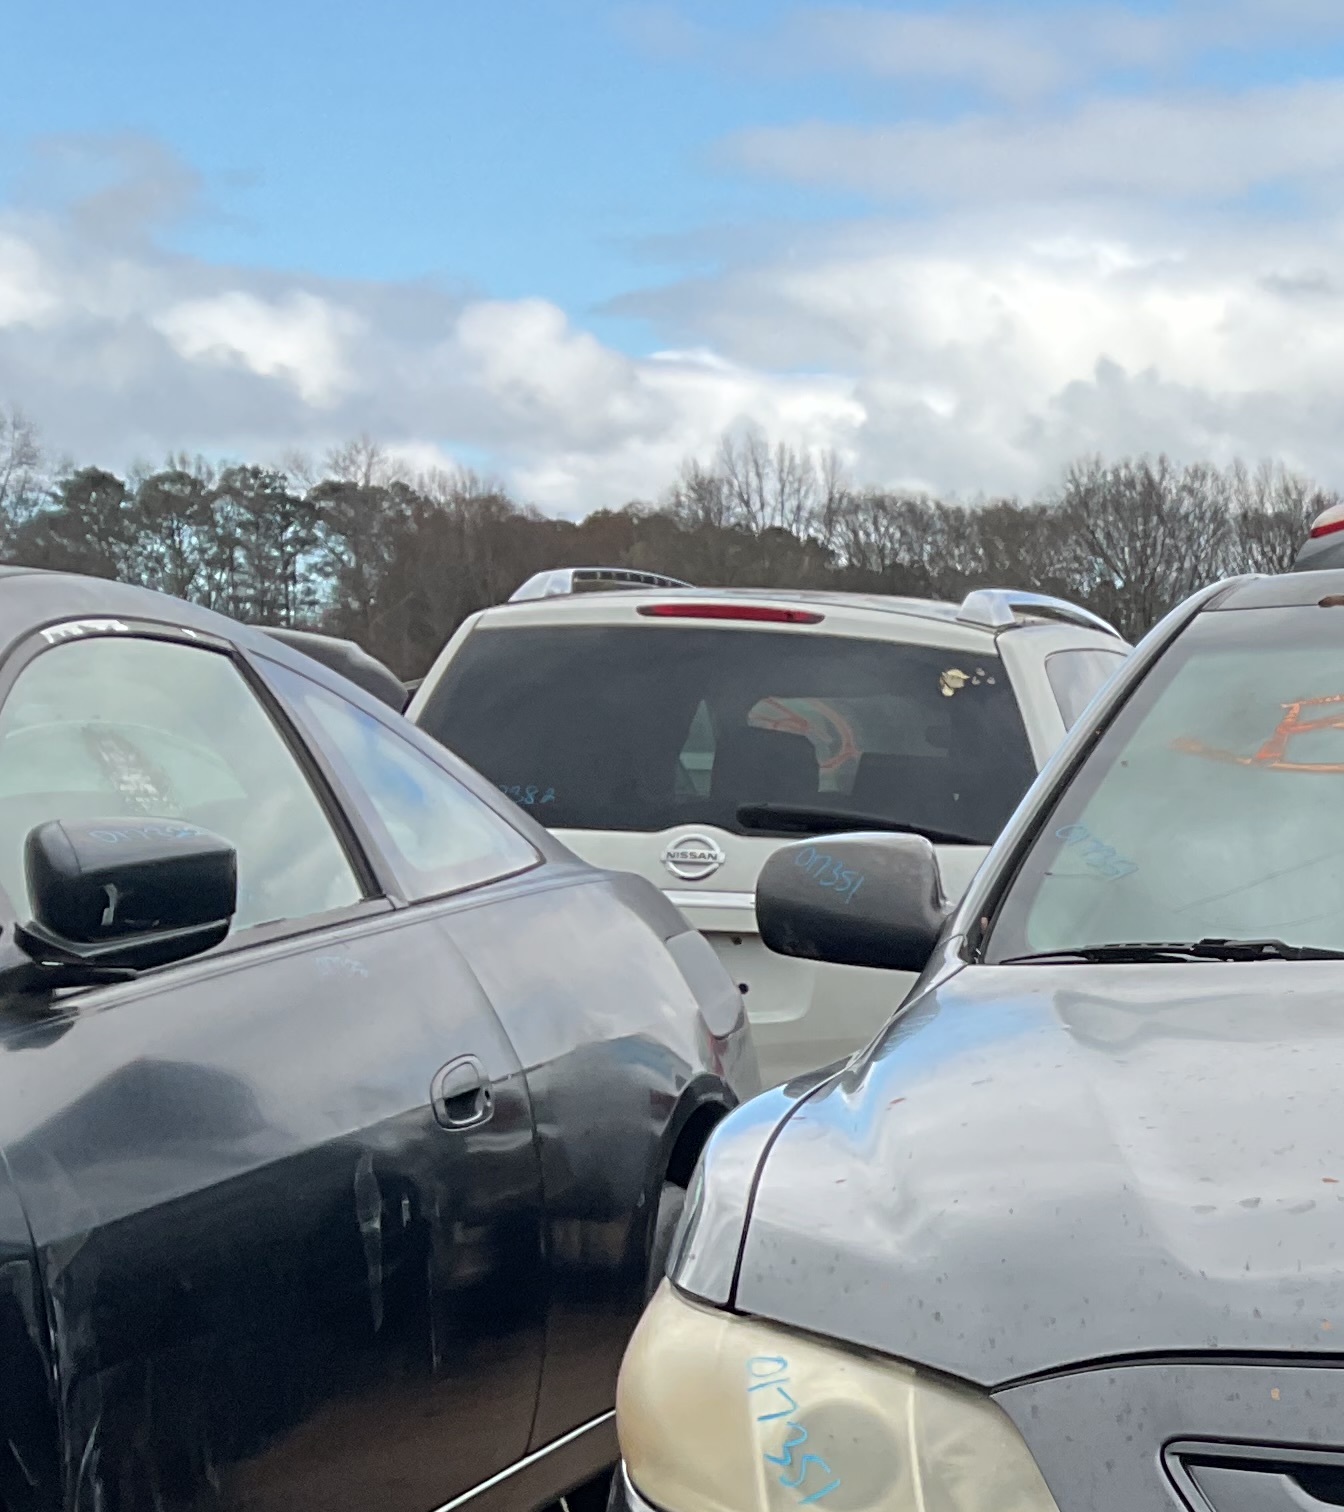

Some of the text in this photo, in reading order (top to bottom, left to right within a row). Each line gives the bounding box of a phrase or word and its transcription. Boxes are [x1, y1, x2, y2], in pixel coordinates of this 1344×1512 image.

[666, 851, 718, 861] NISSAN
[794, 846, 865, 902] 017351
[746, 1355, 842, 1505] 017351
